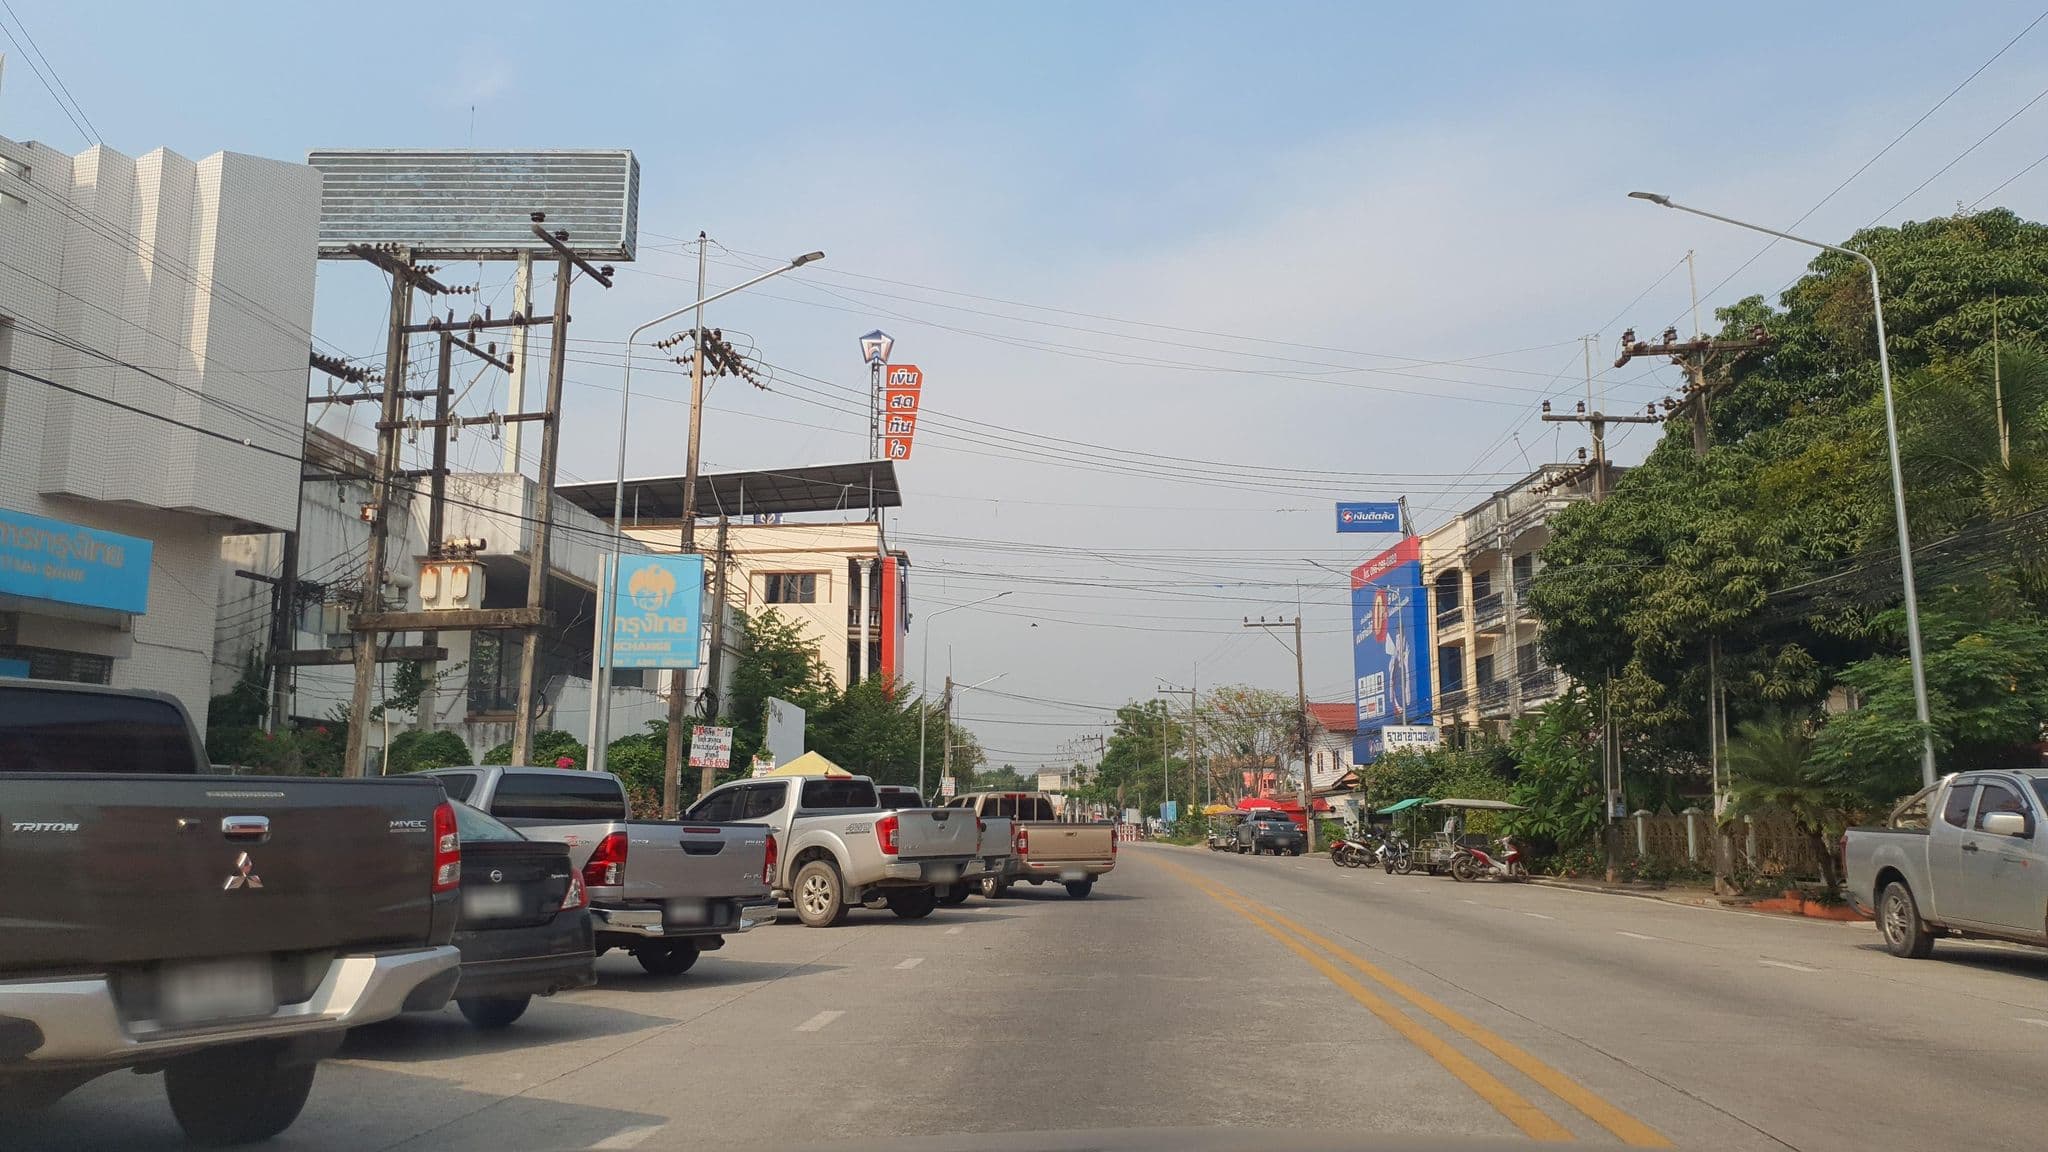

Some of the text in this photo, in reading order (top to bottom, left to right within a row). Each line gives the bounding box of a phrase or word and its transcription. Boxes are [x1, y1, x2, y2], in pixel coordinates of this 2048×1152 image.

[890, 369, 917, 385] เงิน
[891, 394, 914, 408] สด
[890, 439, 906, 457] ใจ
[12, 822, 79, 833] TRITON
[390, 820, 427, 828] MIVEC
